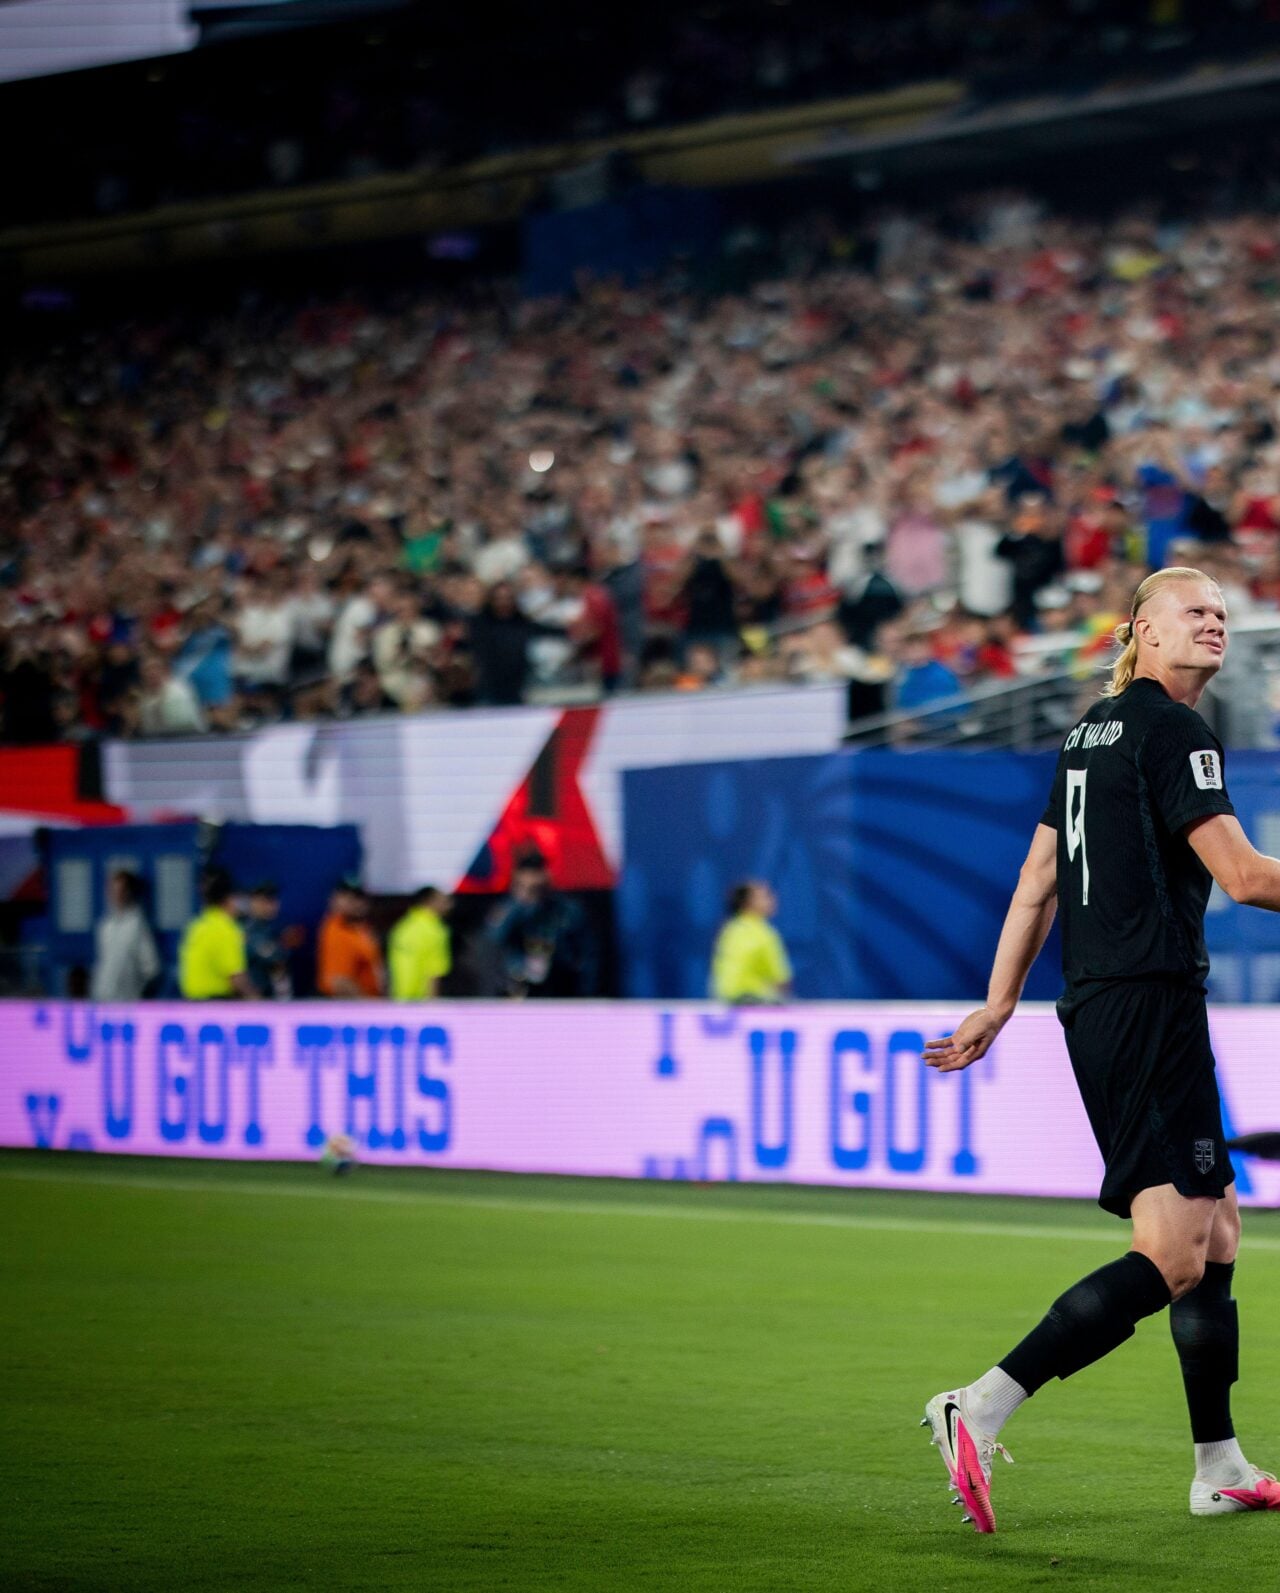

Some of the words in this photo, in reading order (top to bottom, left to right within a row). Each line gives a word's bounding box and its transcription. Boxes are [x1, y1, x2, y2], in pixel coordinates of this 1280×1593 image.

[1066, 768, 1090, 905] 9
[157, 1022, 274, 1148] GOT
[292, 1024, 454, 1154] THIS
